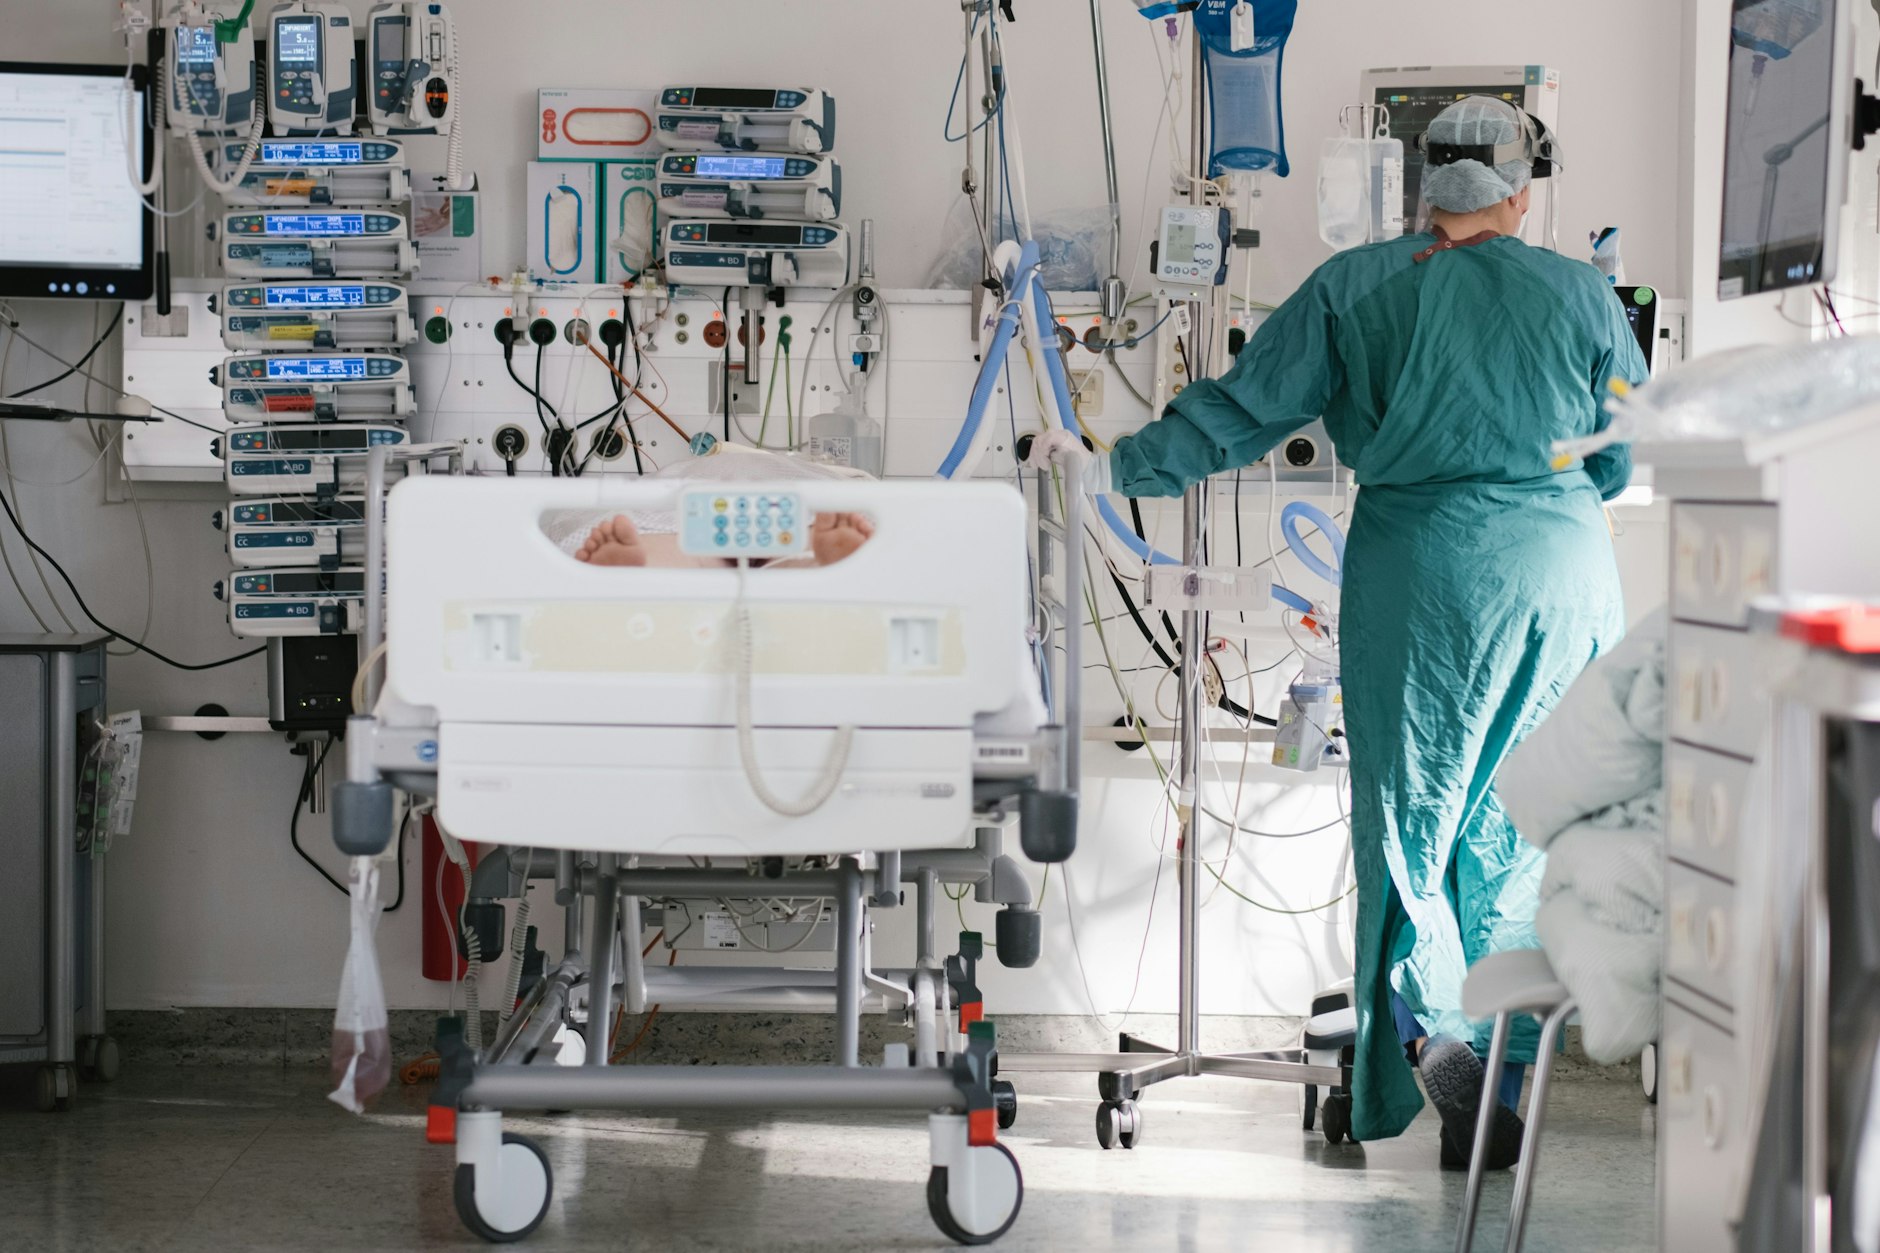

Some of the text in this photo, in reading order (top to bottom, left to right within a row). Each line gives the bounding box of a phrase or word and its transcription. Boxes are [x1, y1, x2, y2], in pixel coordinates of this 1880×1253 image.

[1207, 0, 1226, 9] VBM
[663, 188, 673, 196] CC
[231, 249, 242, 257] CC
[672, 257, 740, 265] CC BD
[232, 394, 244, 402] CC
[234, 463, 305, 474] CC BD
[237, 535, 308, 546] CC BD
[238, 606, 309, 617] CC BD
[113, 717, 132, 726] stryker
